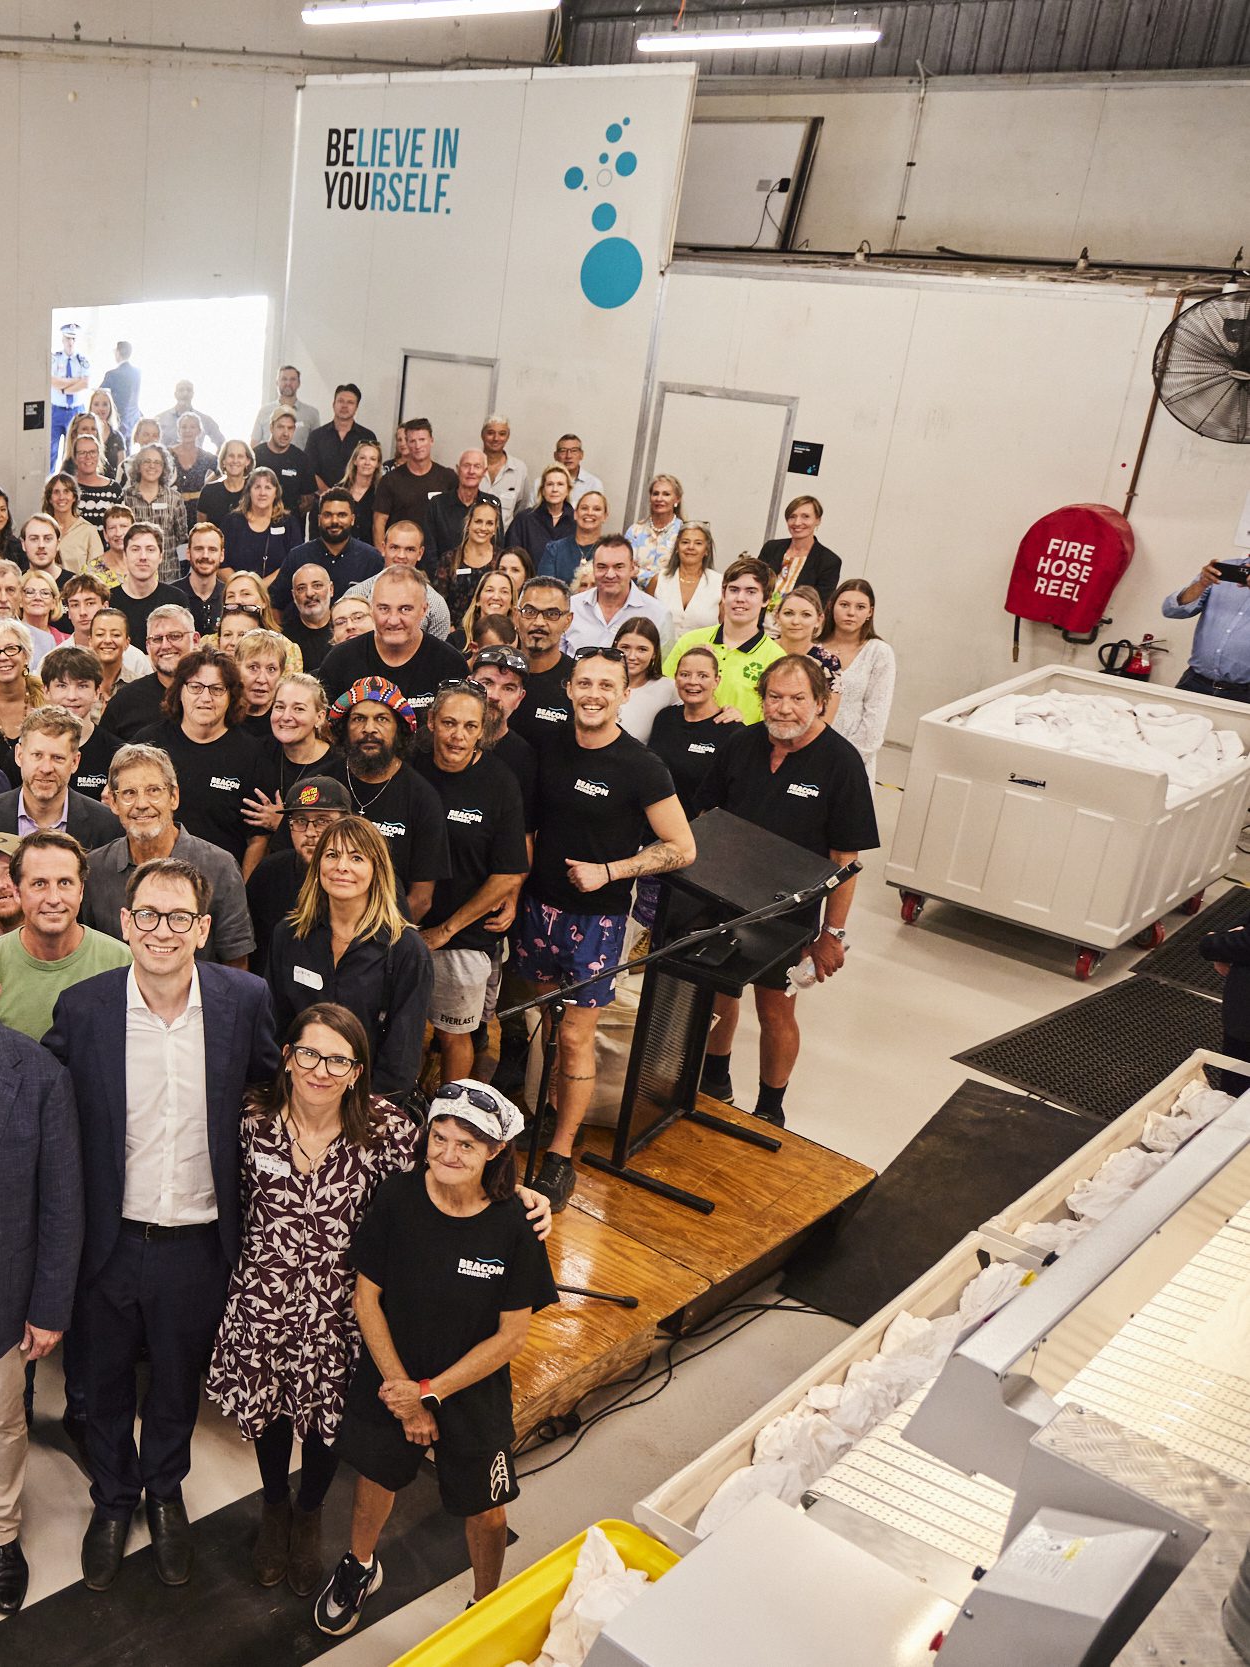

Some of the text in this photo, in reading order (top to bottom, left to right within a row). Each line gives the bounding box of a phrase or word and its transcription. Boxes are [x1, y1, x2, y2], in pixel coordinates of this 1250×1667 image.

[326, 127, 460, 169] BELIEVE IN
[324, 171, 452, 215] YOURSELF.
[1047, 537, 1096, 563] FIRE
[1036, 556, 1093, 584] HOSE
[1034, 576, 1080, 603] REEL
[407, 697, 435, 705] BEACON
[536, 707, 568, 722] BEACON
[690, 743, 716, 754] BEACON
[77, 776, 108, 785] BEACON
[211, 776, 240, 790] BEACON
[576, 778, 610, 797] BEACON
[299, 786, 318, 801] SANTA
[789, 783, 820, 798] BEACON
[302, 793, 318, 805] CRUZ
[449, 809, 483, 823] BEACON
[440, 1013, 475, 1026] EVERLAST
[457, 1267, 491, 1280] LAUNDRY.
[459, 1258, 505, 1275] BEACON
